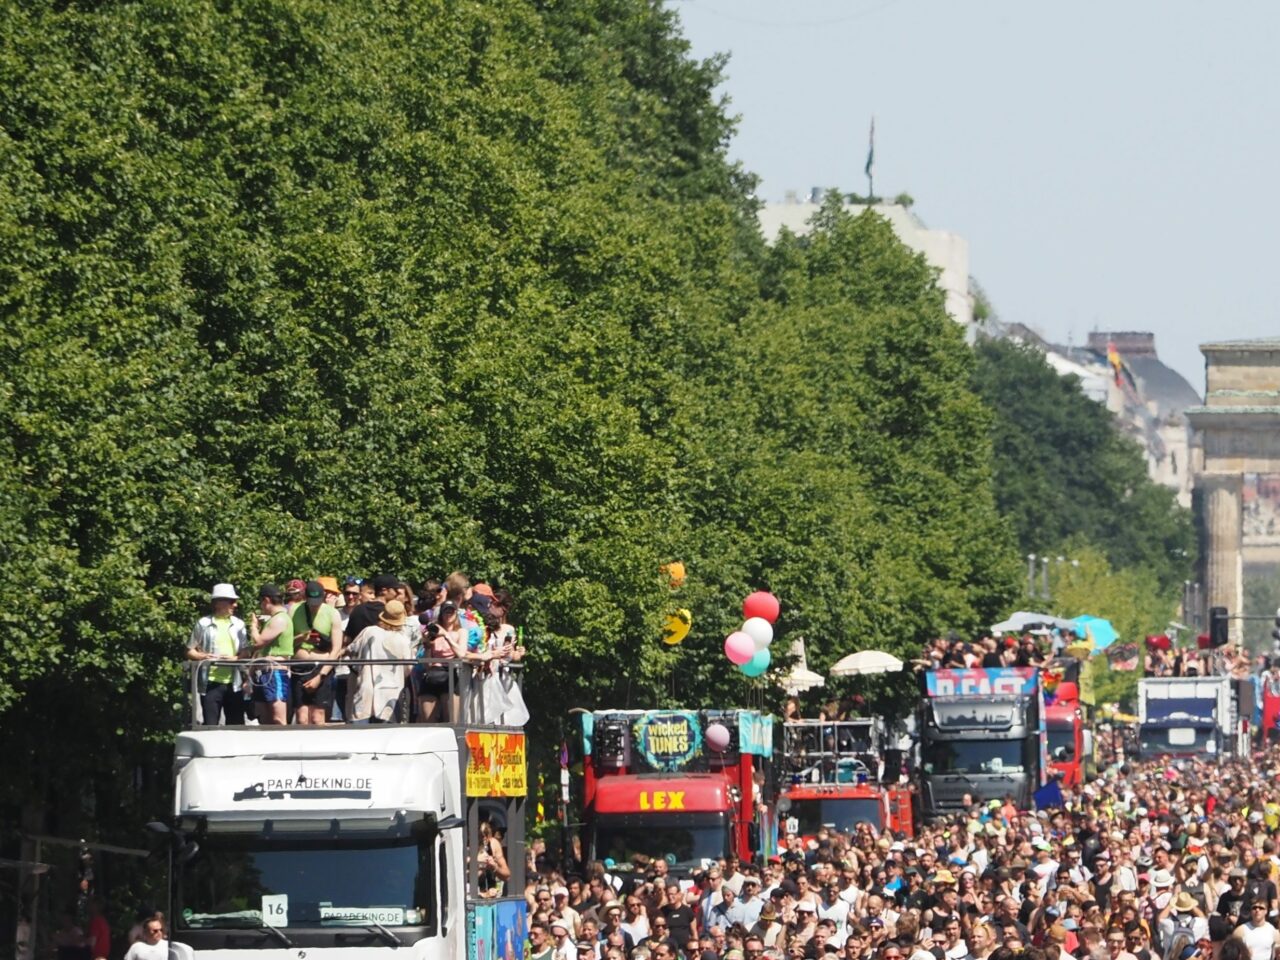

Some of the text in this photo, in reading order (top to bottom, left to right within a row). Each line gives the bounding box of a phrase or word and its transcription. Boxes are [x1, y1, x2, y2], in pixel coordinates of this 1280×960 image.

[647, 719, 688, 736] wicked
[648, 736, 689, 754] TUNES
[267, 778, 373, 790] PARADEKING.DE
[639, 791, 686, 810] LEX
[268, 903, 284, 915] 16
